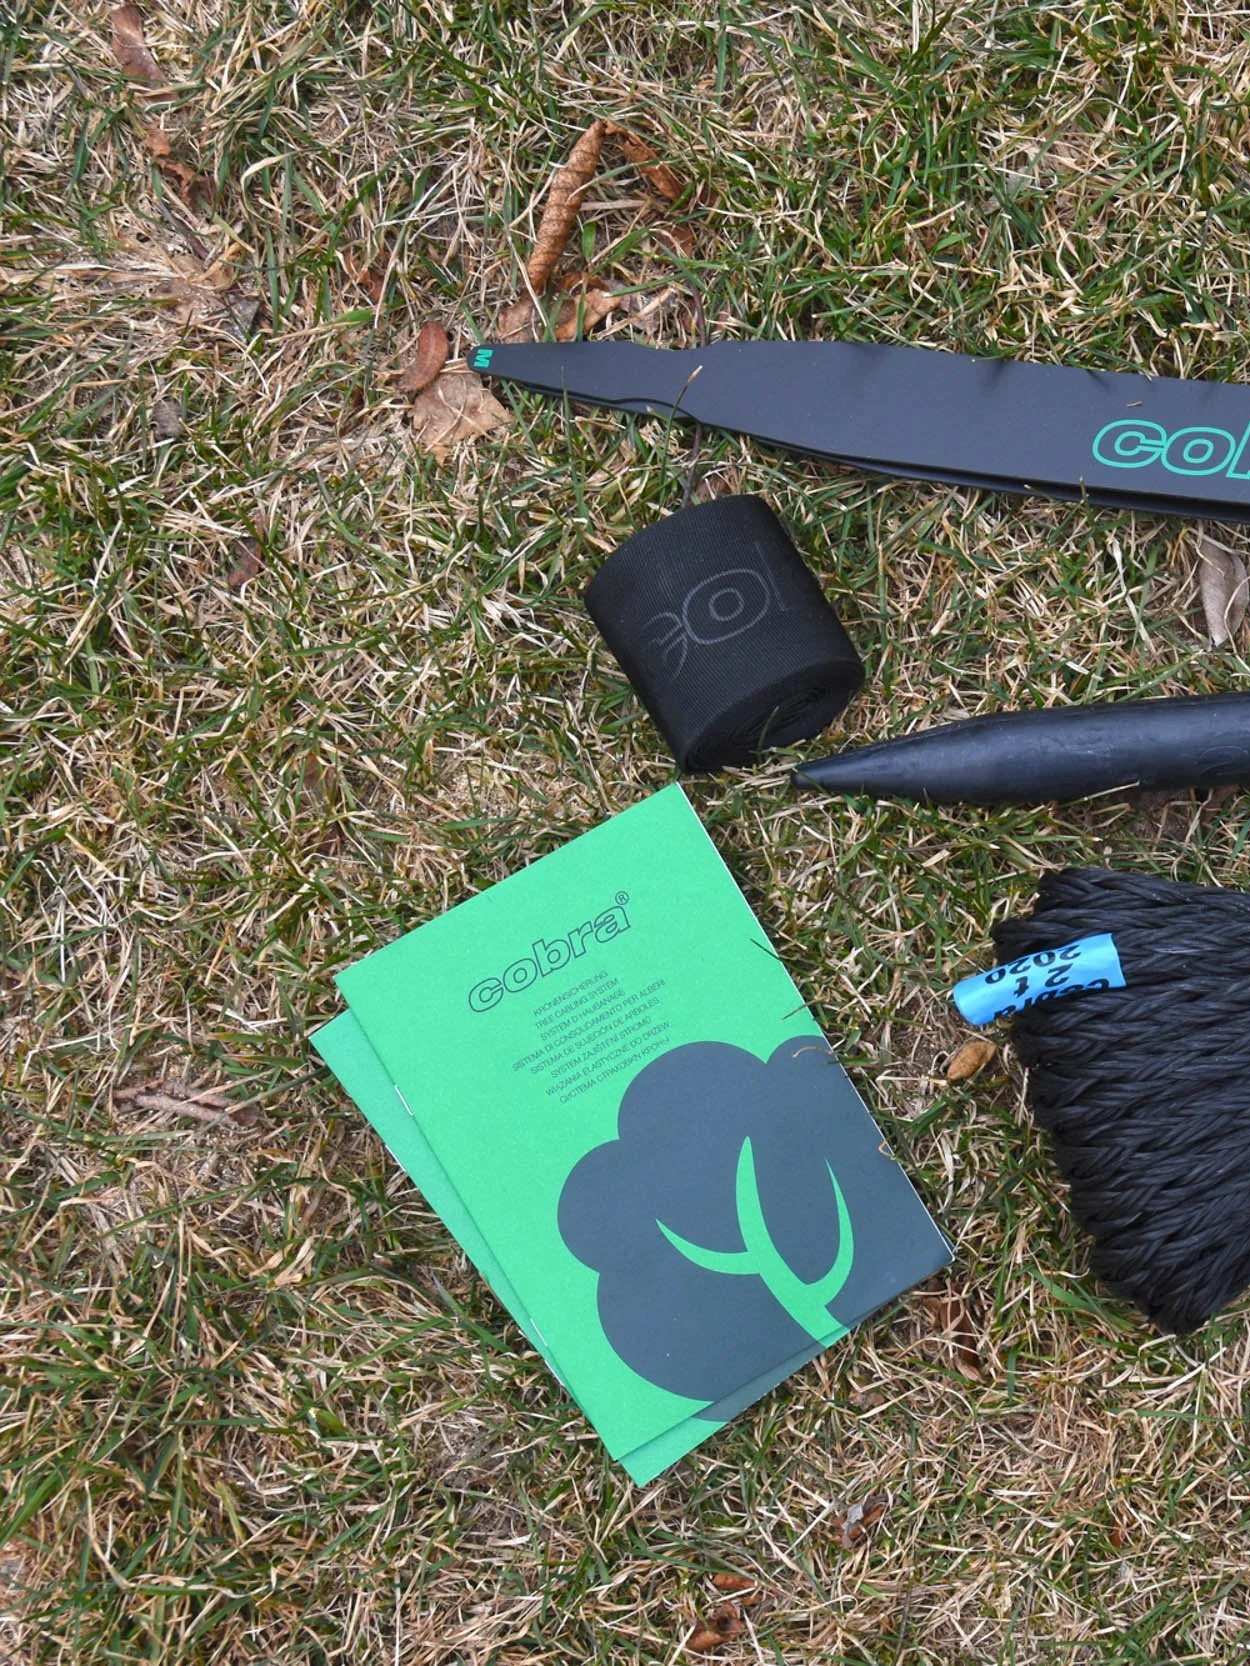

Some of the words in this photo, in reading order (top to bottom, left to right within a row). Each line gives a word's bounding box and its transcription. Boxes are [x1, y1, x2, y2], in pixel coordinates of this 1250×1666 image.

[984, 944, 1082, 985] 2020
[1044, 962, 1073, 988] 2
[535, 1014, 554, 1028] TREE
[554, 995, 587, 1017] CABLING
[588, 978, 618, 999] SYSTEM
[511, 1048, 544, 1070] SISTEMA
[544, 1043, 553, 1051] DI
[623, 994, 638, 1006] PER
[530, 1052, 562, 1074] SISTEMA
[563, 1046, 574, 1055] DE
[612, 1017, 624, 1027] DE
[540, 1018, 571, 1040] SYSTEM
[582, 1044, 630, 1074] ELASTYCZNE
[630, 1037, 641, 1047] DO
[642, 1021, 669, 1039] DRZEW
[550, 1056, 582, 1078] SYSTEM
